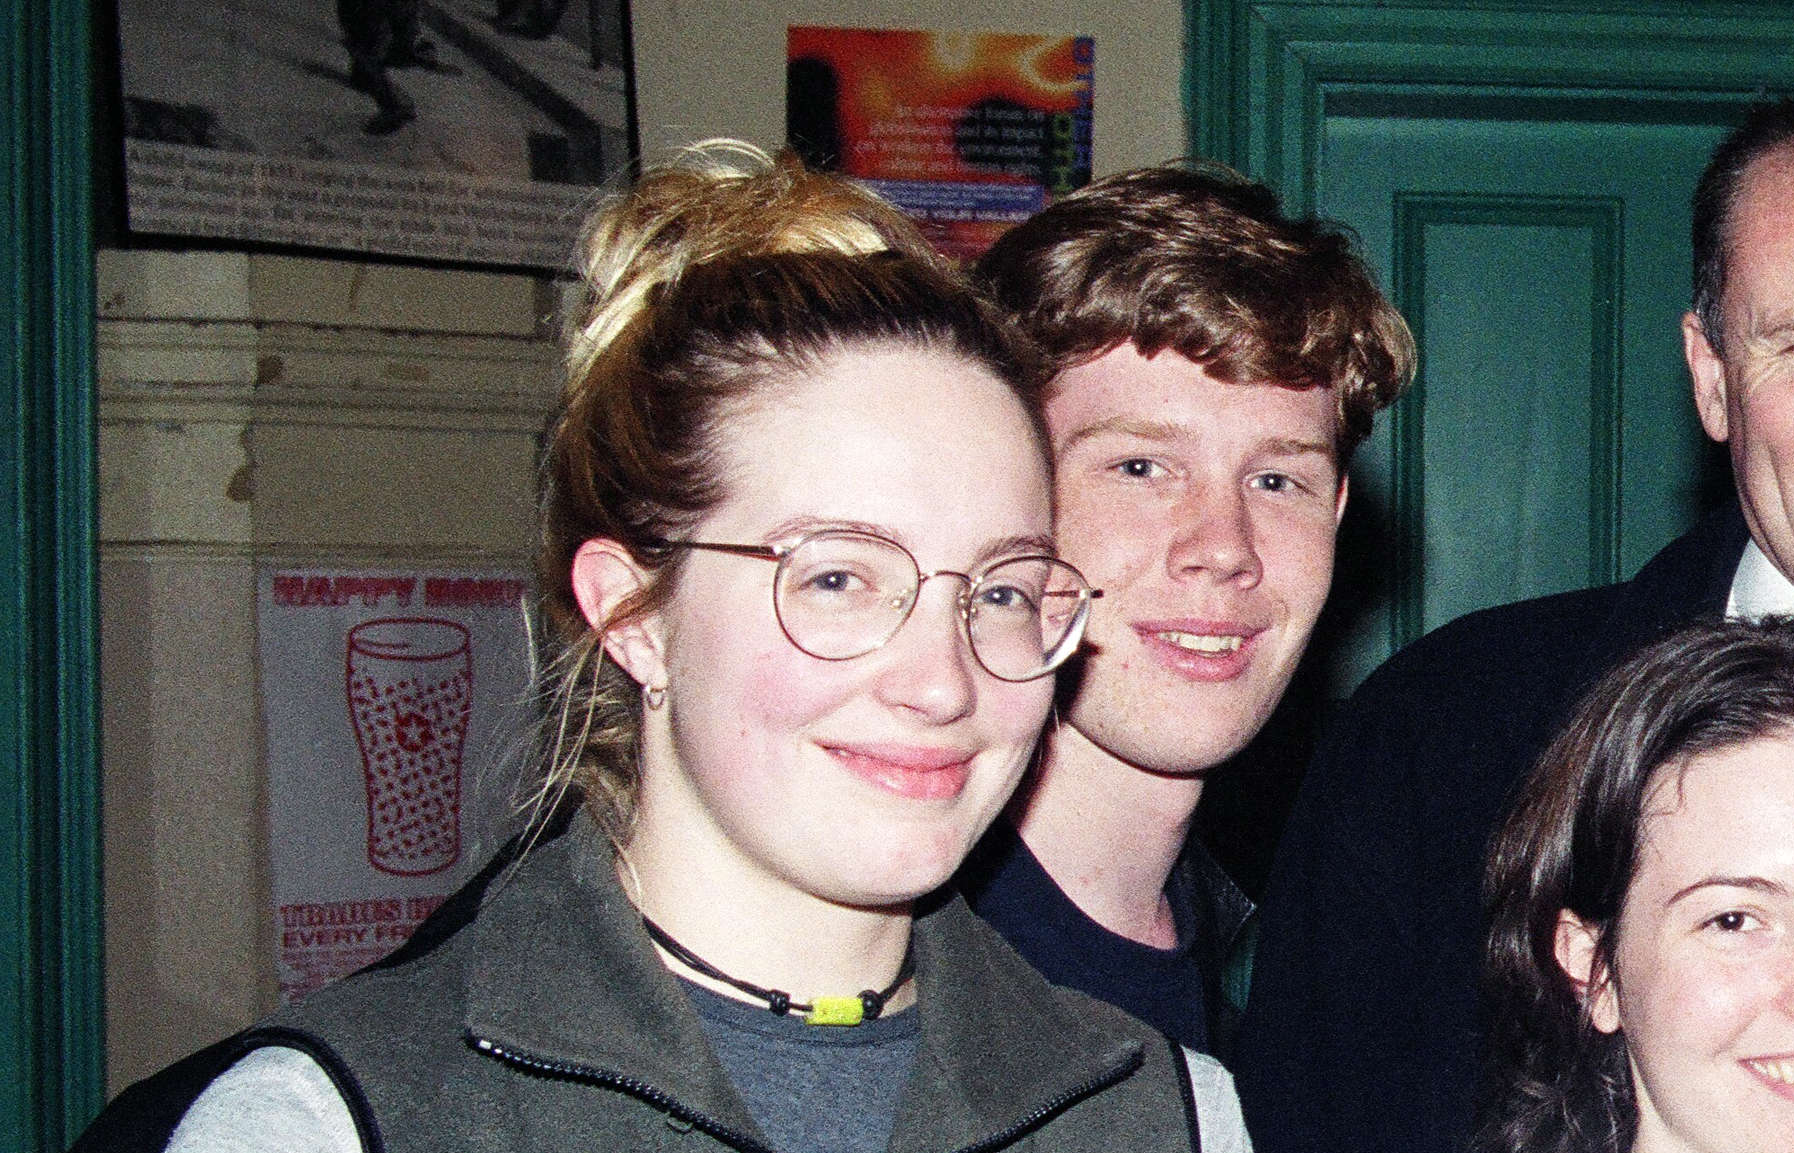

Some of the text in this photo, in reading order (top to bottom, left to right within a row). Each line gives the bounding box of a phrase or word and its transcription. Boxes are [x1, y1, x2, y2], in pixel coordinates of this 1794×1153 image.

[274, 576, 523, 607] HAPPY HOUR
[282, 928, 367, 948] EVERY
